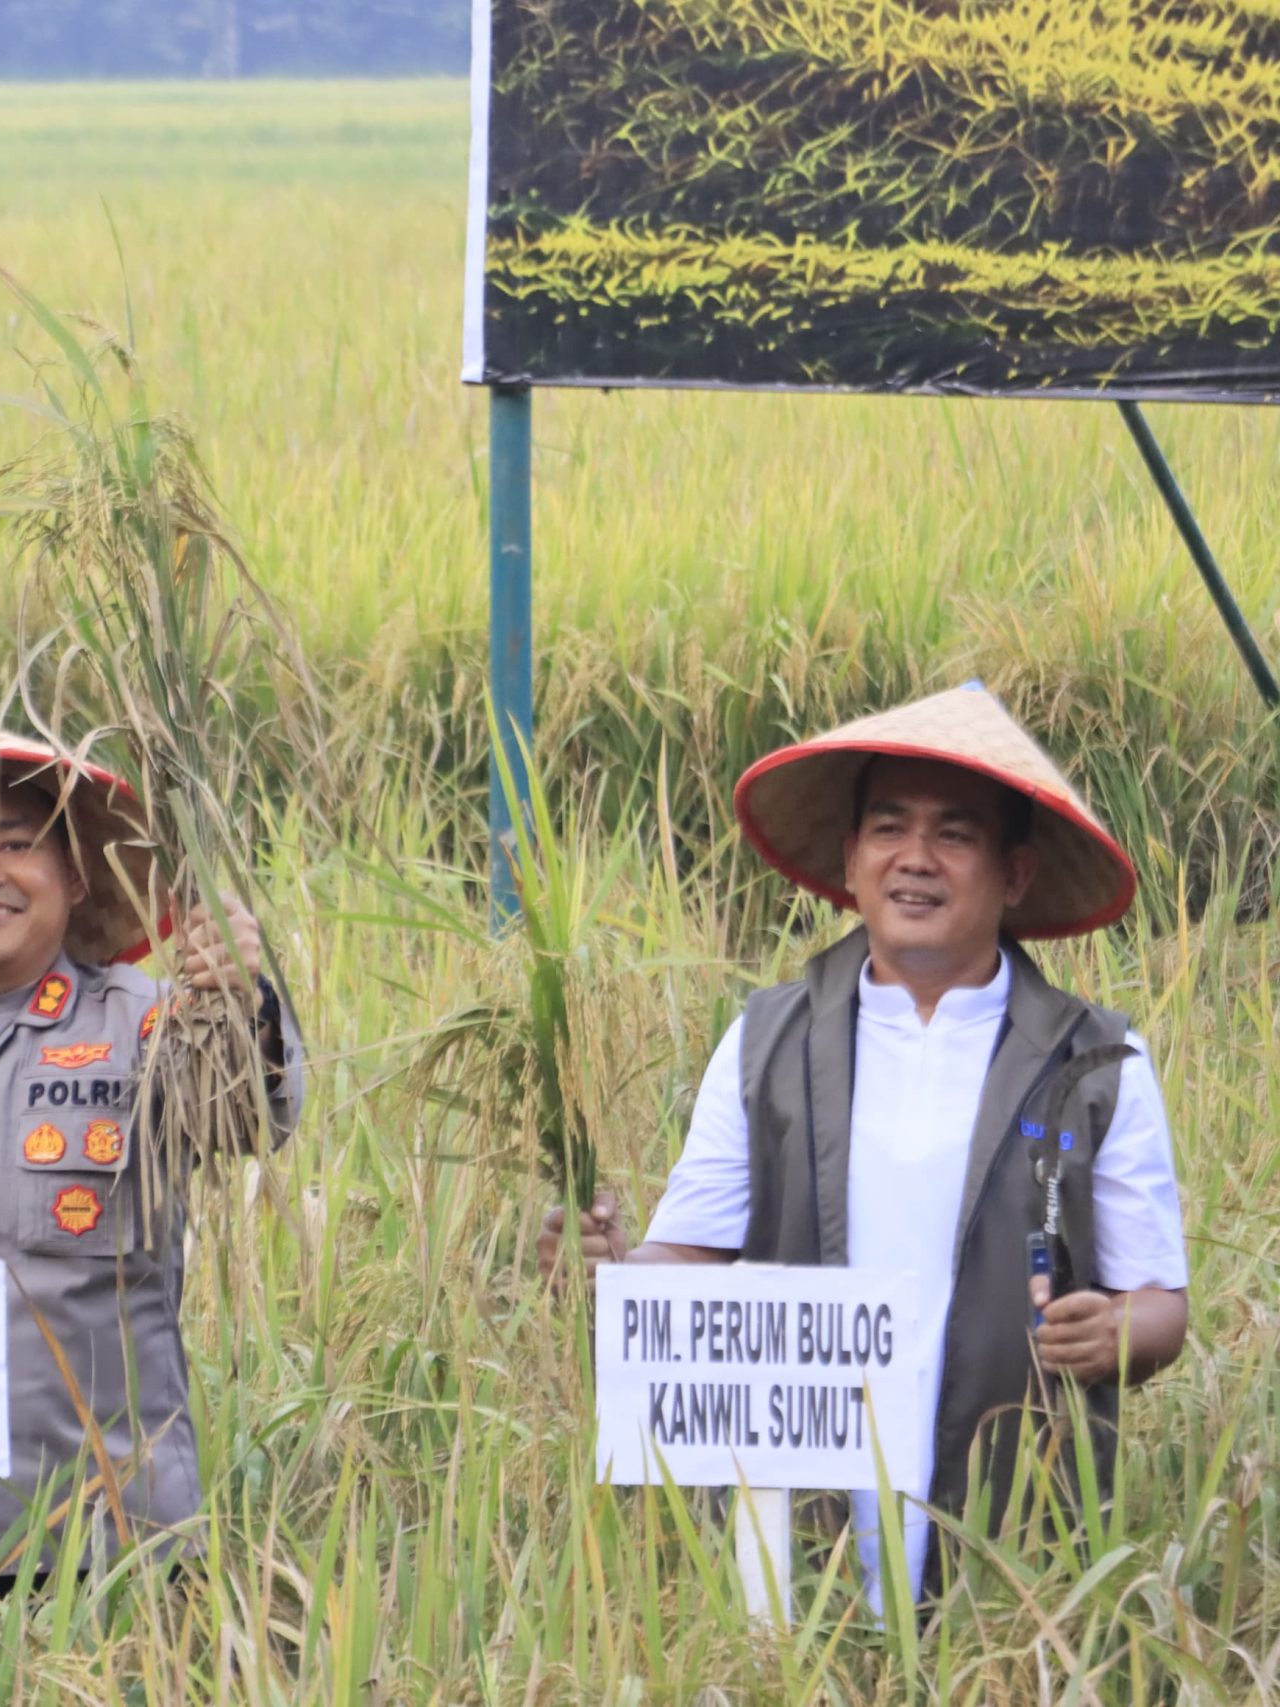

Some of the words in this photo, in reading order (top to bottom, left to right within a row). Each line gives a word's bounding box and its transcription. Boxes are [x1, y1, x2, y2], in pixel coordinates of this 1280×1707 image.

[28, 1080, 121, 1108] POLRI
[1020, 1119, 1072, 1150] bug
[622, 1298, 682, 1362] PIM.
[691, 1300, 786, 1364] PERUM
[797, 1302, 893, 1367] BULOG
[649, 1382, 759, 1446] KANWIL
[769, 1384, 866, 1449] SUMUT
